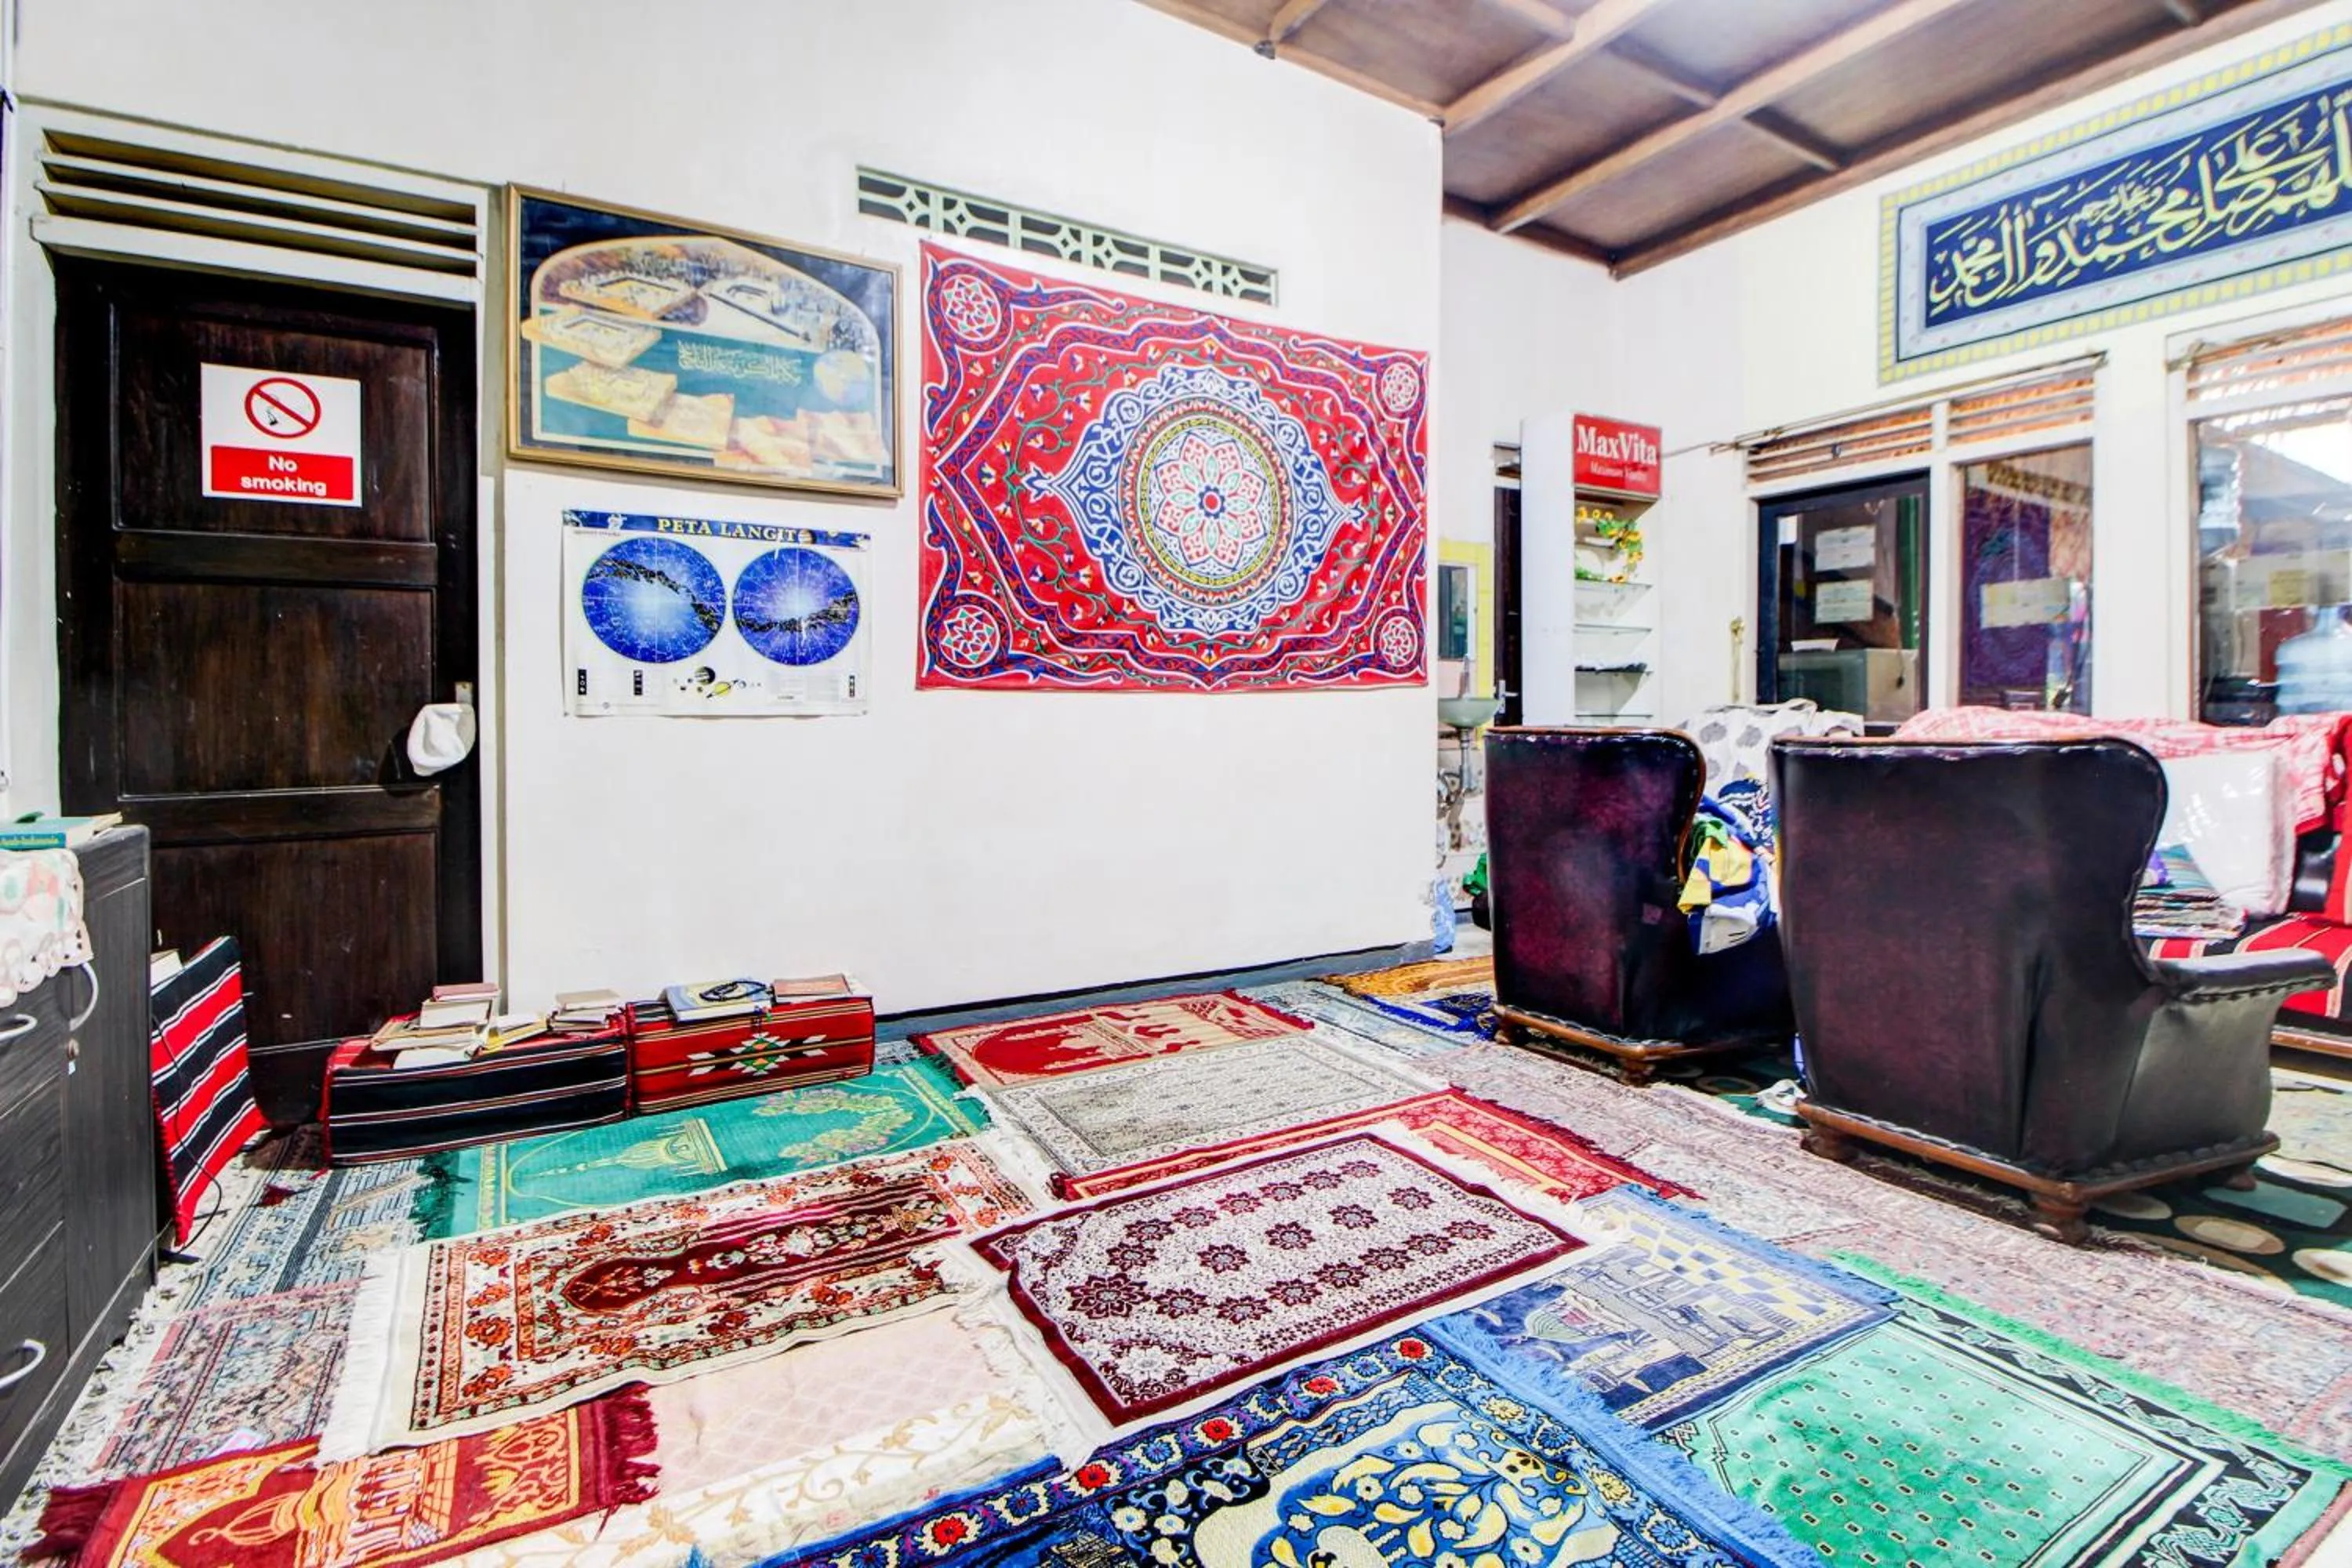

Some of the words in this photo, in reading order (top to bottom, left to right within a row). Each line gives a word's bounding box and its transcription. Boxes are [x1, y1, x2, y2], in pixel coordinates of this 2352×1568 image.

[1577, 424, 1657, 466] MaxVita
[268, 456, 298, 473] No
[240, 476, 327, 497] smoking
[657, 517, 713, 535] PETA
[719, 523, 797, 543] LANGIT
